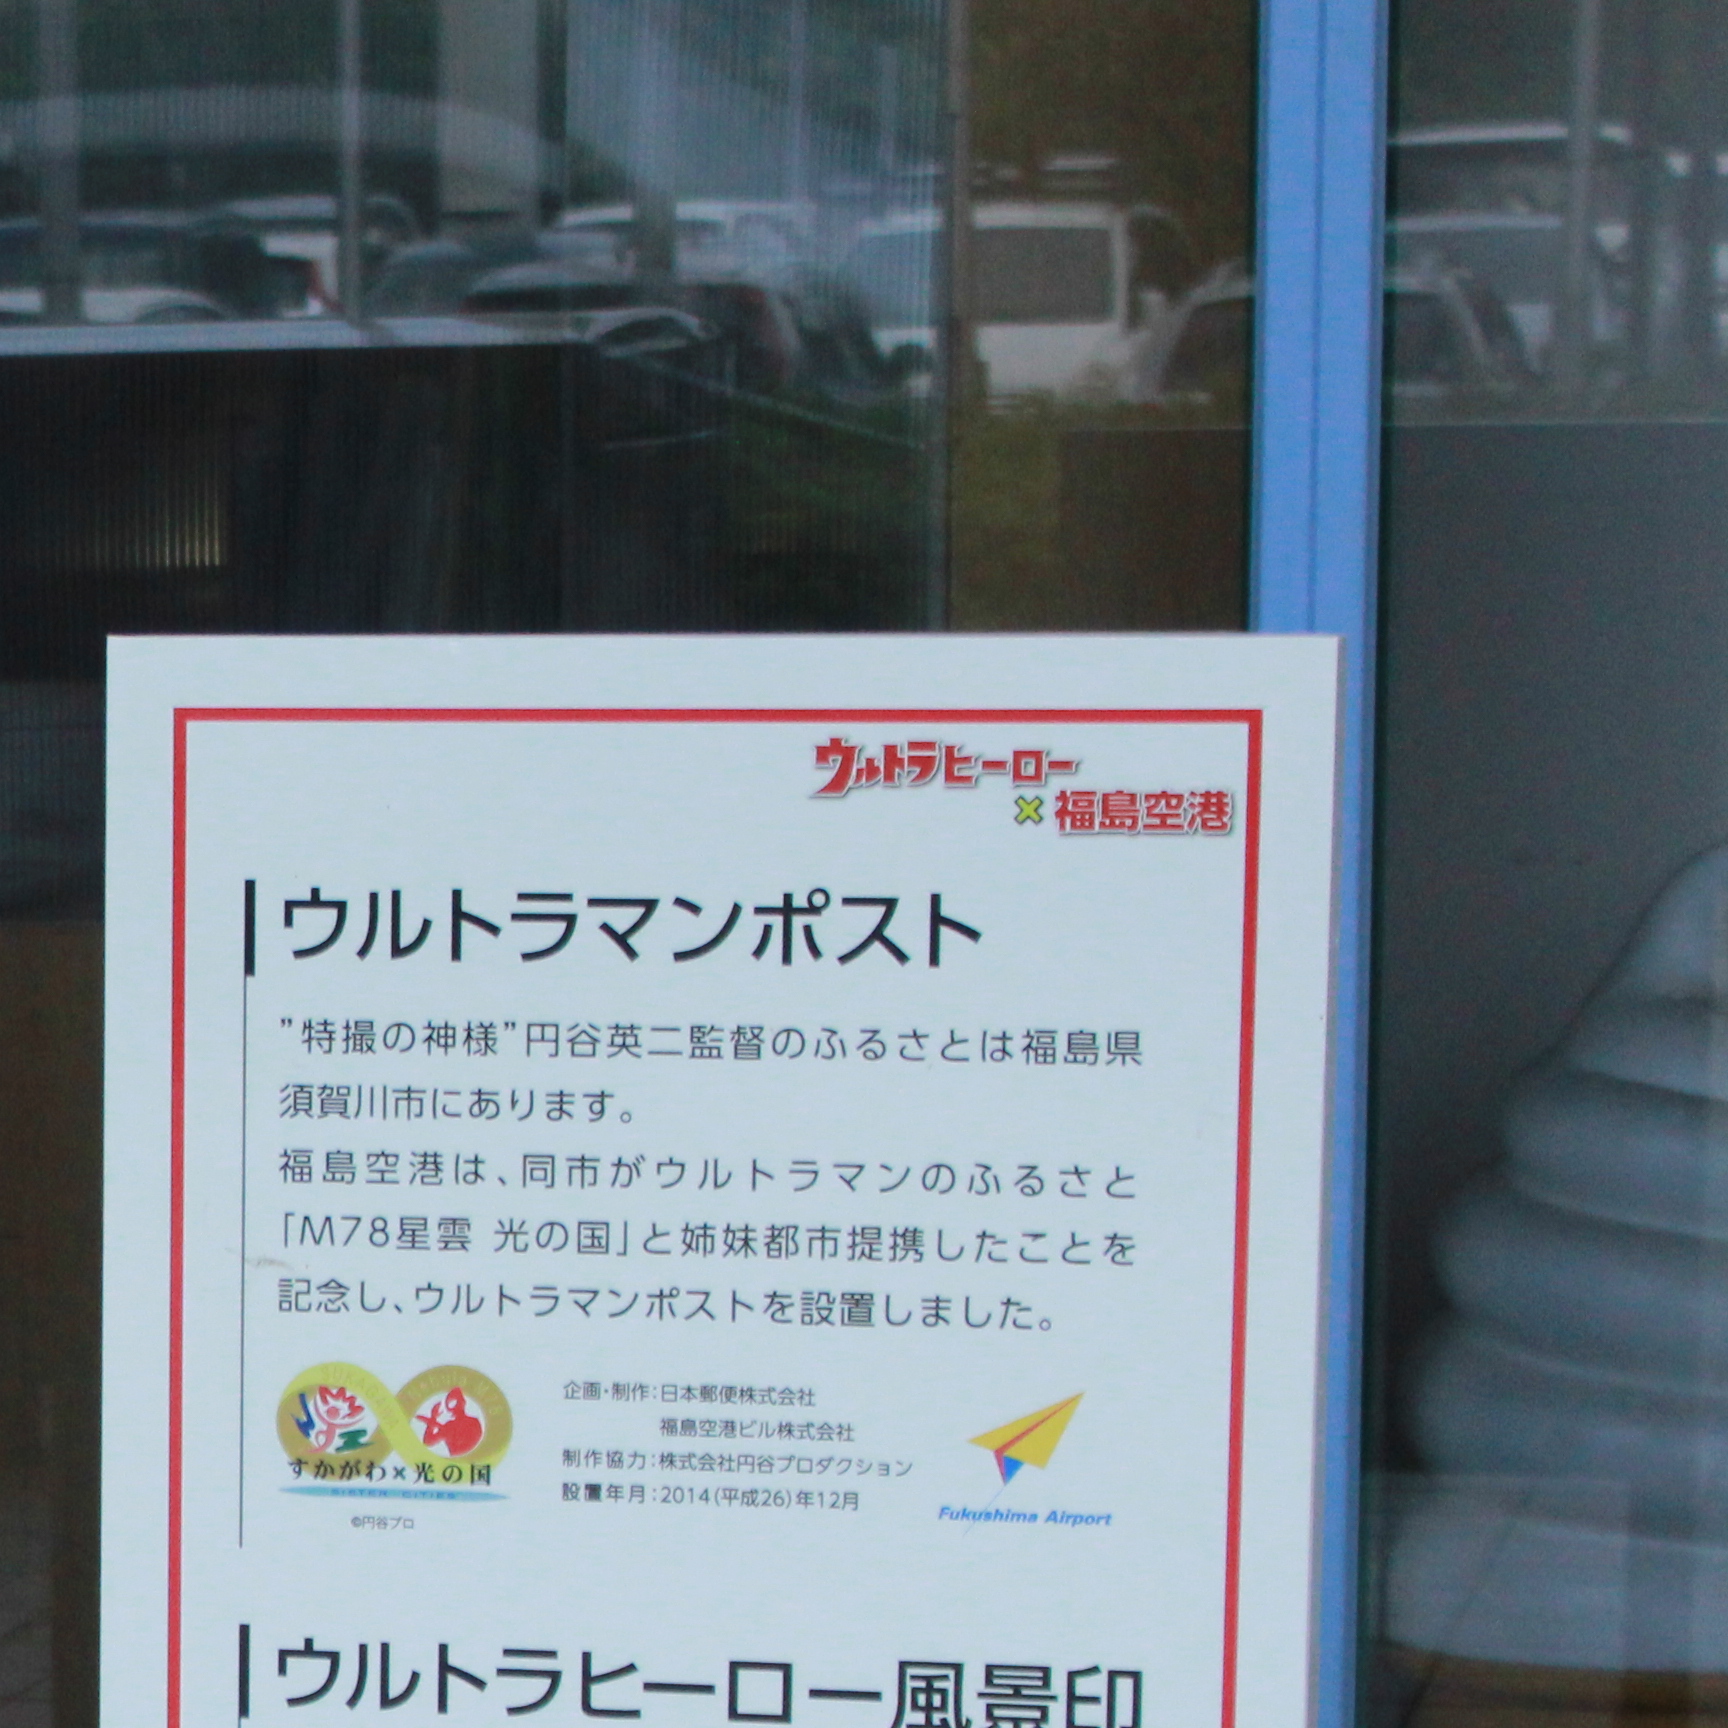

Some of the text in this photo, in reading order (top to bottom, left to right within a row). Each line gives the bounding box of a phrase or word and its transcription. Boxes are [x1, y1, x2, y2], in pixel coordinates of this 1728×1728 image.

[809, 738, 1080, 798] ウルトラヒーロー
[1055, 790, 1233, 836] 福島空港
[283, 887, 982, 967] ウルトラマンポスト
[279, 1083, 632, 1124] 須賀川市にあります。
[278, 1149, 1136, 1199] 福島空港は、同市がウルトラマンのふるさと
[493, 1217, 1136, 1266] 光の国」と姉妹都市提携したことを
[277, 1278, 1052, 1332] 記念し、ウルトラマンポストを設置しました。
[659, 1418, 855, 1442] 福島空港ビル株式会社
[938, 1506, 1112, 1527] Fukushima Airport
